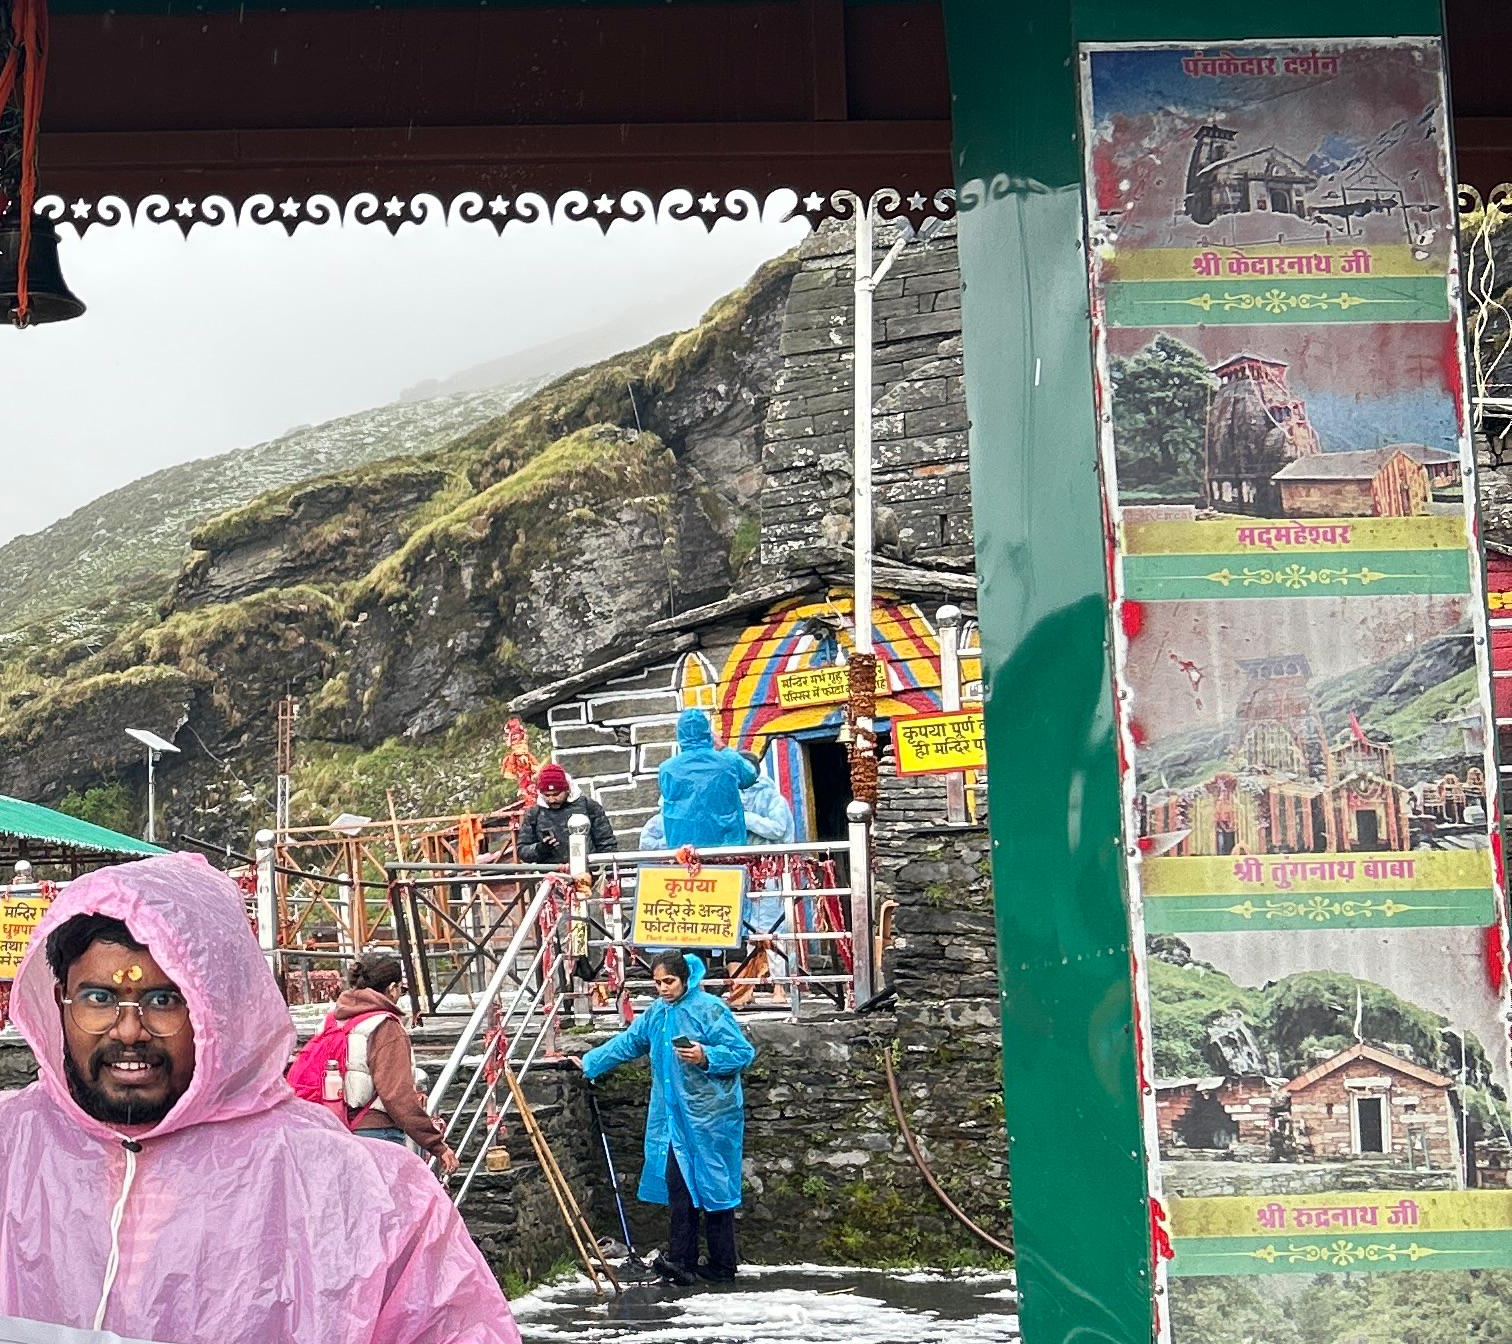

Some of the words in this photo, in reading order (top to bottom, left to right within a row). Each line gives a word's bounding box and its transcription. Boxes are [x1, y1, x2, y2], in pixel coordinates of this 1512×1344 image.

[1182, 51, 1278, 77] पंचकेदार
[1283, 48, 1339, 75] दर्शन
[1192, 251, 1221, 276] श्री
[1226, 250, 1332, 274] केदारनाथ
[1339, 249, 1371, 273] जी
[902, 723, 947, 744] कृपया
[1233, 857, 1263, 882] श्री
[1270, 856, 1355, 889] तुंगनाथ
[1362, 859, 1415, 879] बाबा
[664, 878, 717, 898] कृपया
[4, 902, 37, 921] मन्दिर
[643, 899, 680, 918] मन्दिर
[1257, 1203, 1285, 1228] श्री
[1291, 1206, 1378, 1227] रुद्रनाथ
[1385, 1199, 1419, 1225] जी
